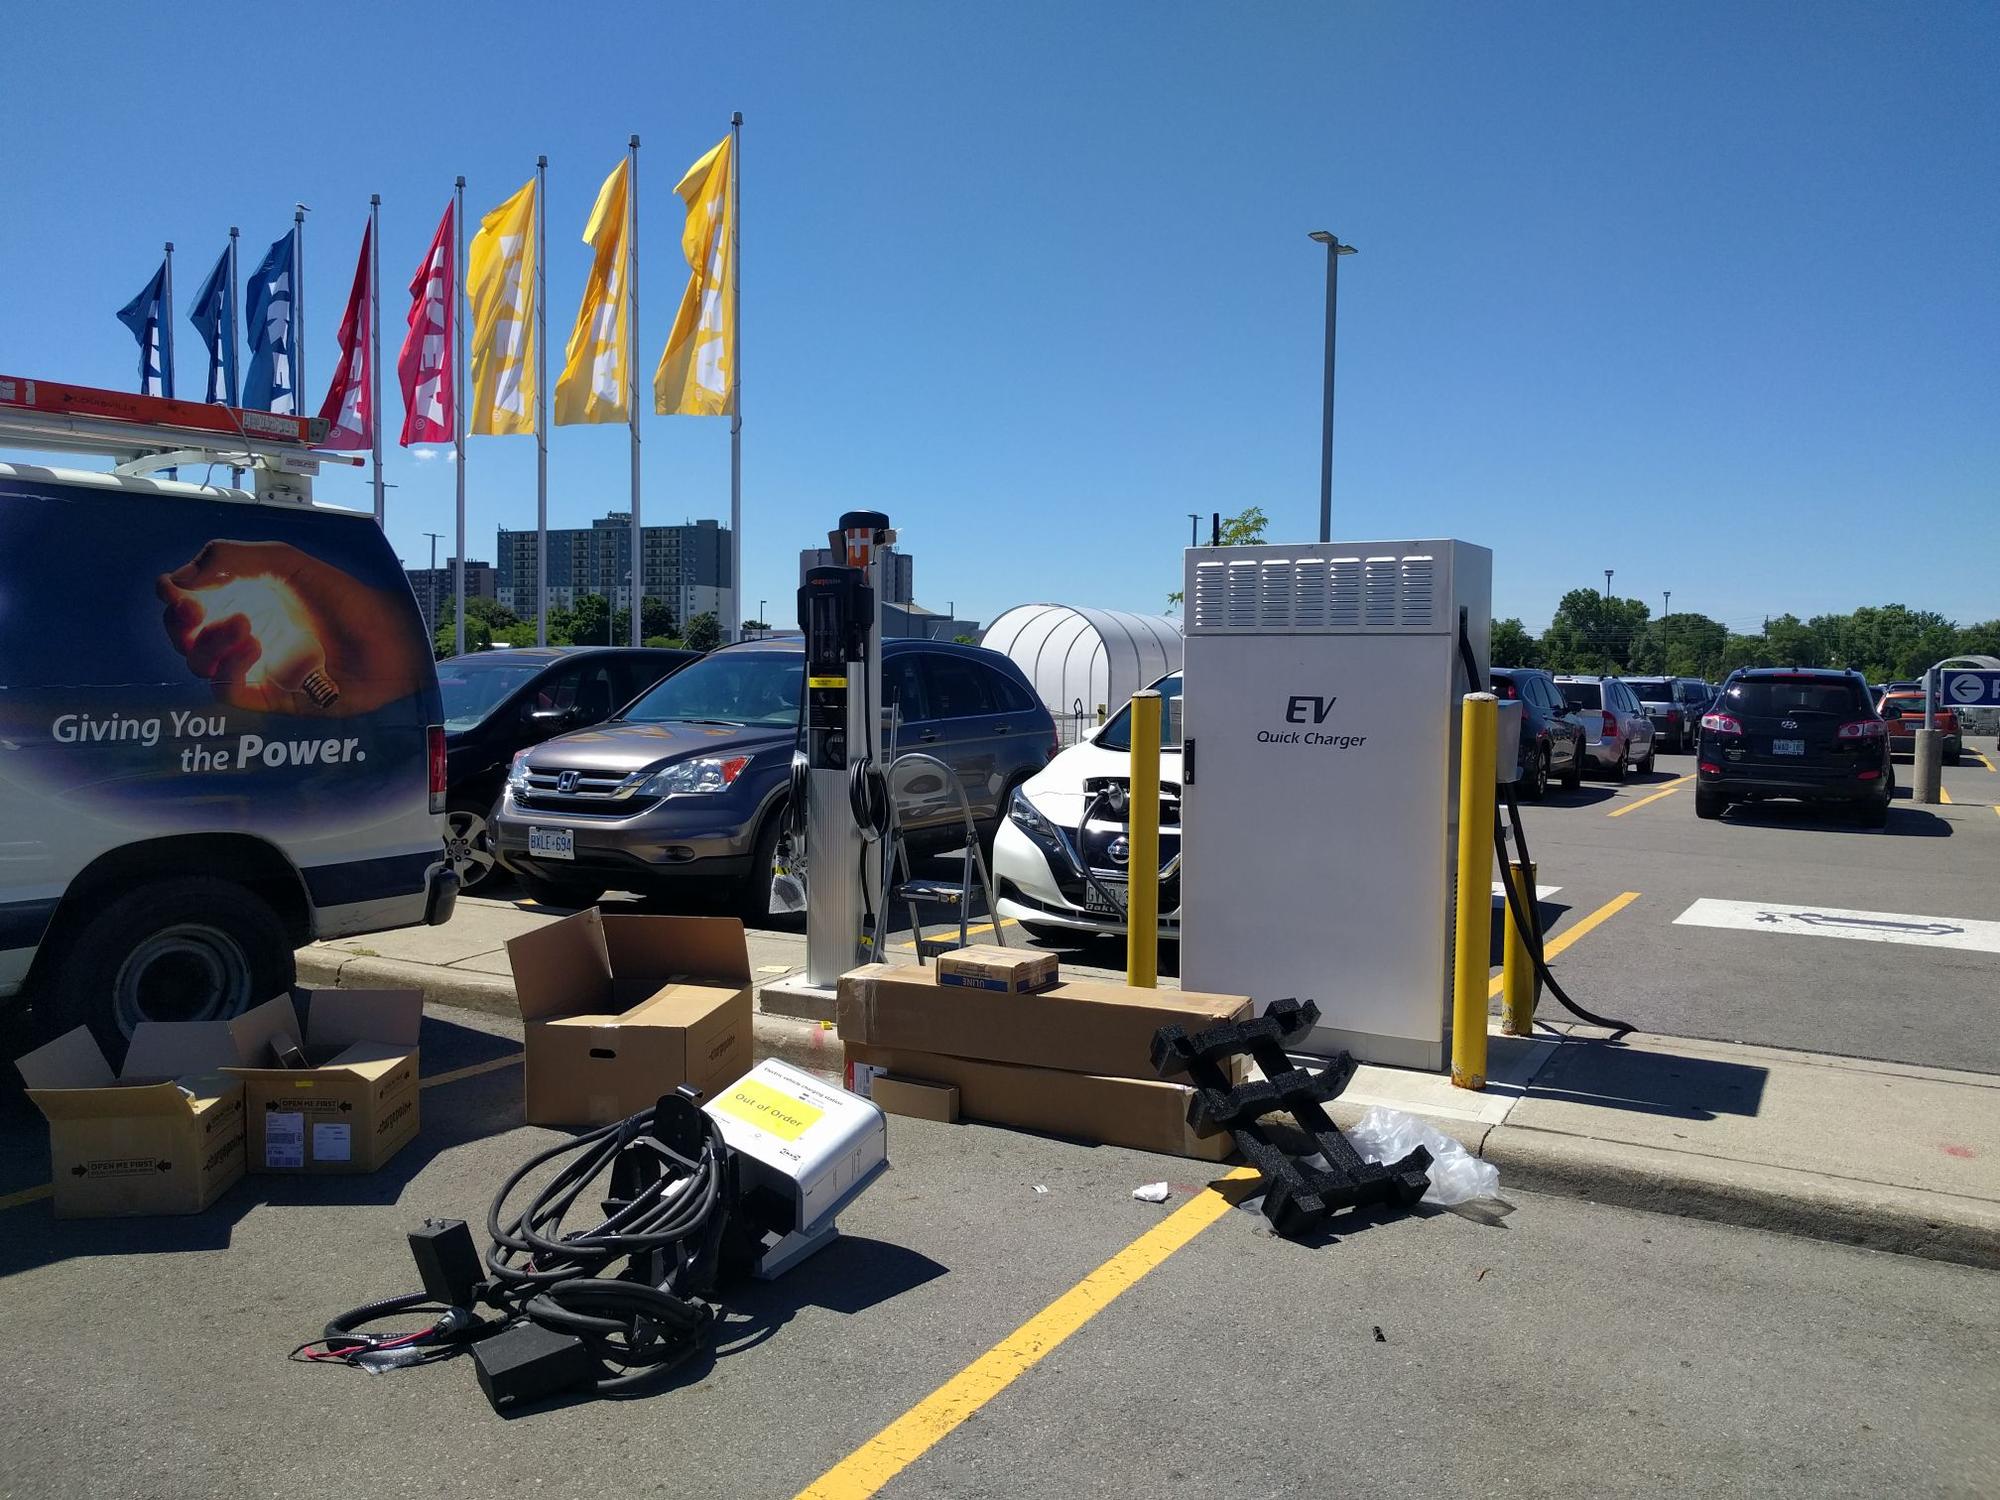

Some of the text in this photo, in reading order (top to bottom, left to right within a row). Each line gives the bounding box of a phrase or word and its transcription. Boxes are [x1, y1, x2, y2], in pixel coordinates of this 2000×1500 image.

[1285, 695, 1337, 724] EV
[51, 710, 226, 747] Giving You
[1257, 730, 1367, 749] Quick Charger
[181, 734, 367, 773] the Power.
[962, 977, 985, 989] ULINE
[735, 1093, 803, 1127] Out of Order
[90, 1160, 153, 1171] OPEN ME FIRST
